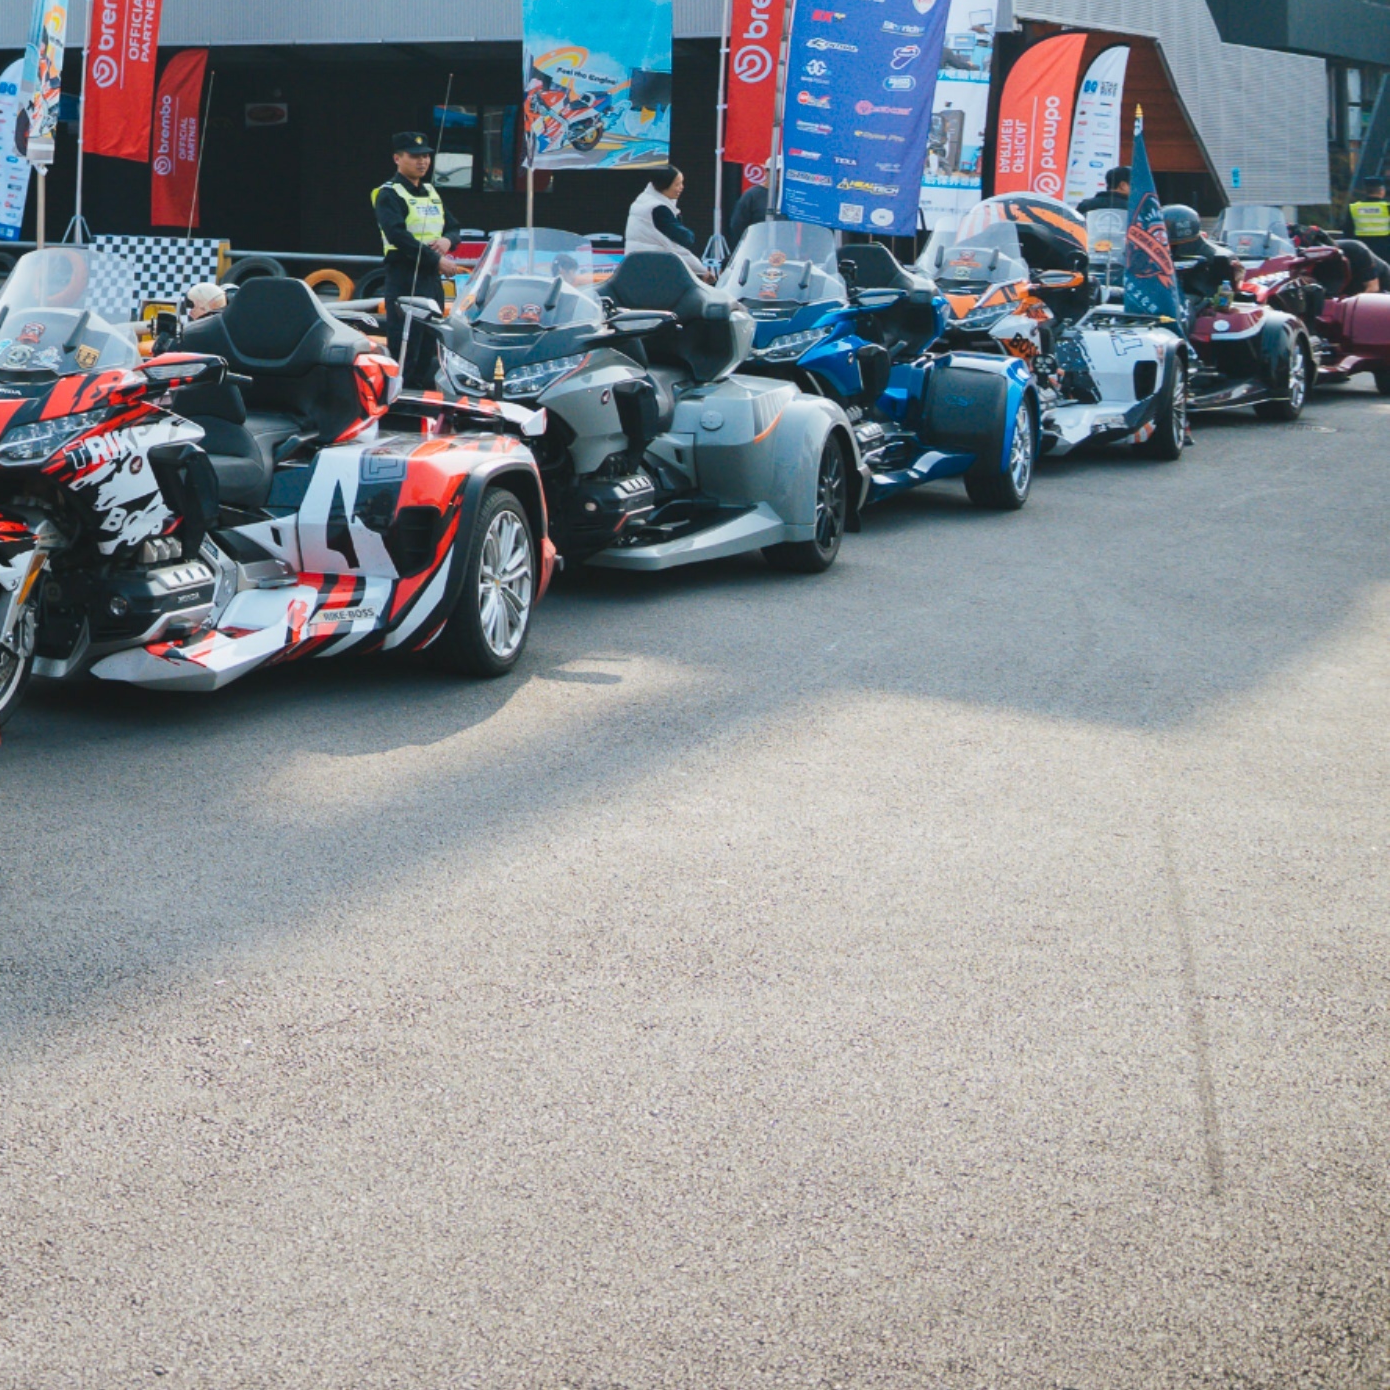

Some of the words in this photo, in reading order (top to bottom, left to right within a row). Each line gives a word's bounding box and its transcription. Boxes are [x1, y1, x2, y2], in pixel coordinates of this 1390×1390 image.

[157, 95, 173, 154] brembo
[177, 117, 189, 161] OFFICIAL
[186, 117, 198, 163] PARTNER
[64, 425, 148, 470] TRIKE
